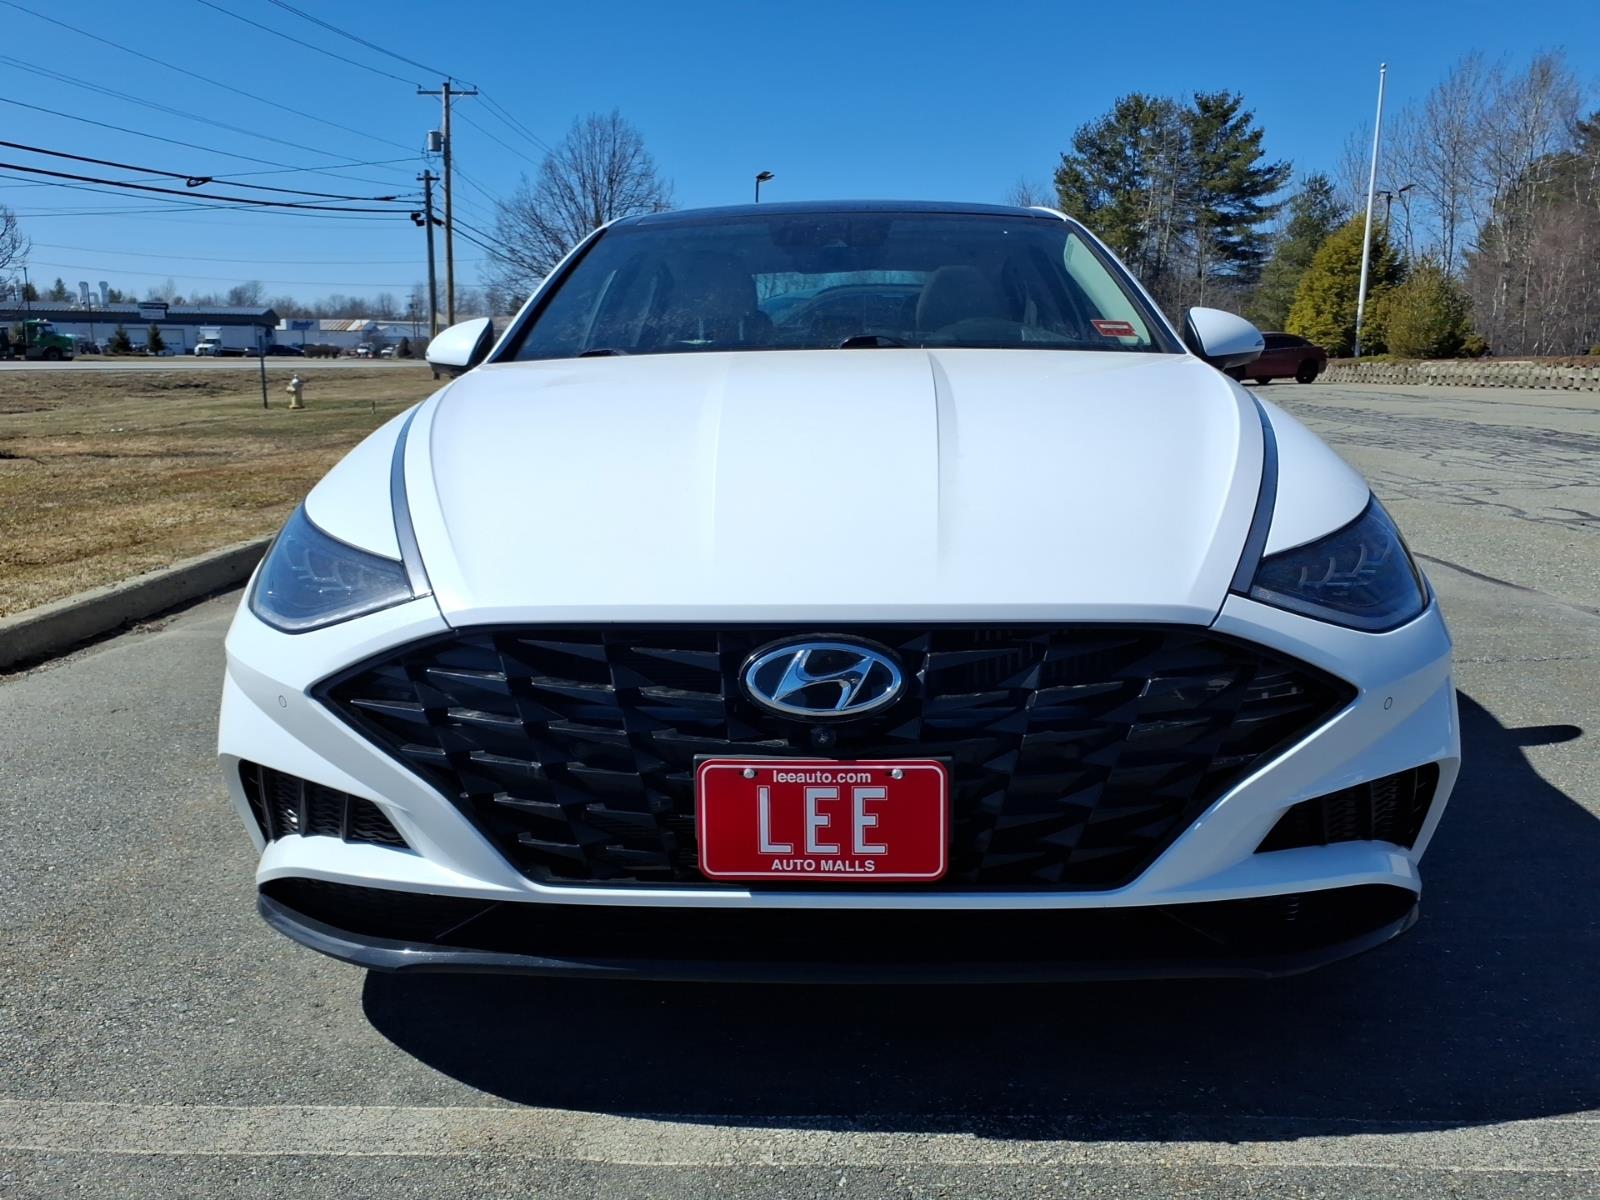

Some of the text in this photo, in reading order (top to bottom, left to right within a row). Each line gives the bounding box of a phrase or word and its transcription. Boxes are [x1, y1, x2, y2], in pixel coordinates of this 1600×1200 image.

[773, 770, 871, 783] leeauto.com
[757, 785, 888, 855] LEE
[771, 860, 875, 872] AUTO MALLS
